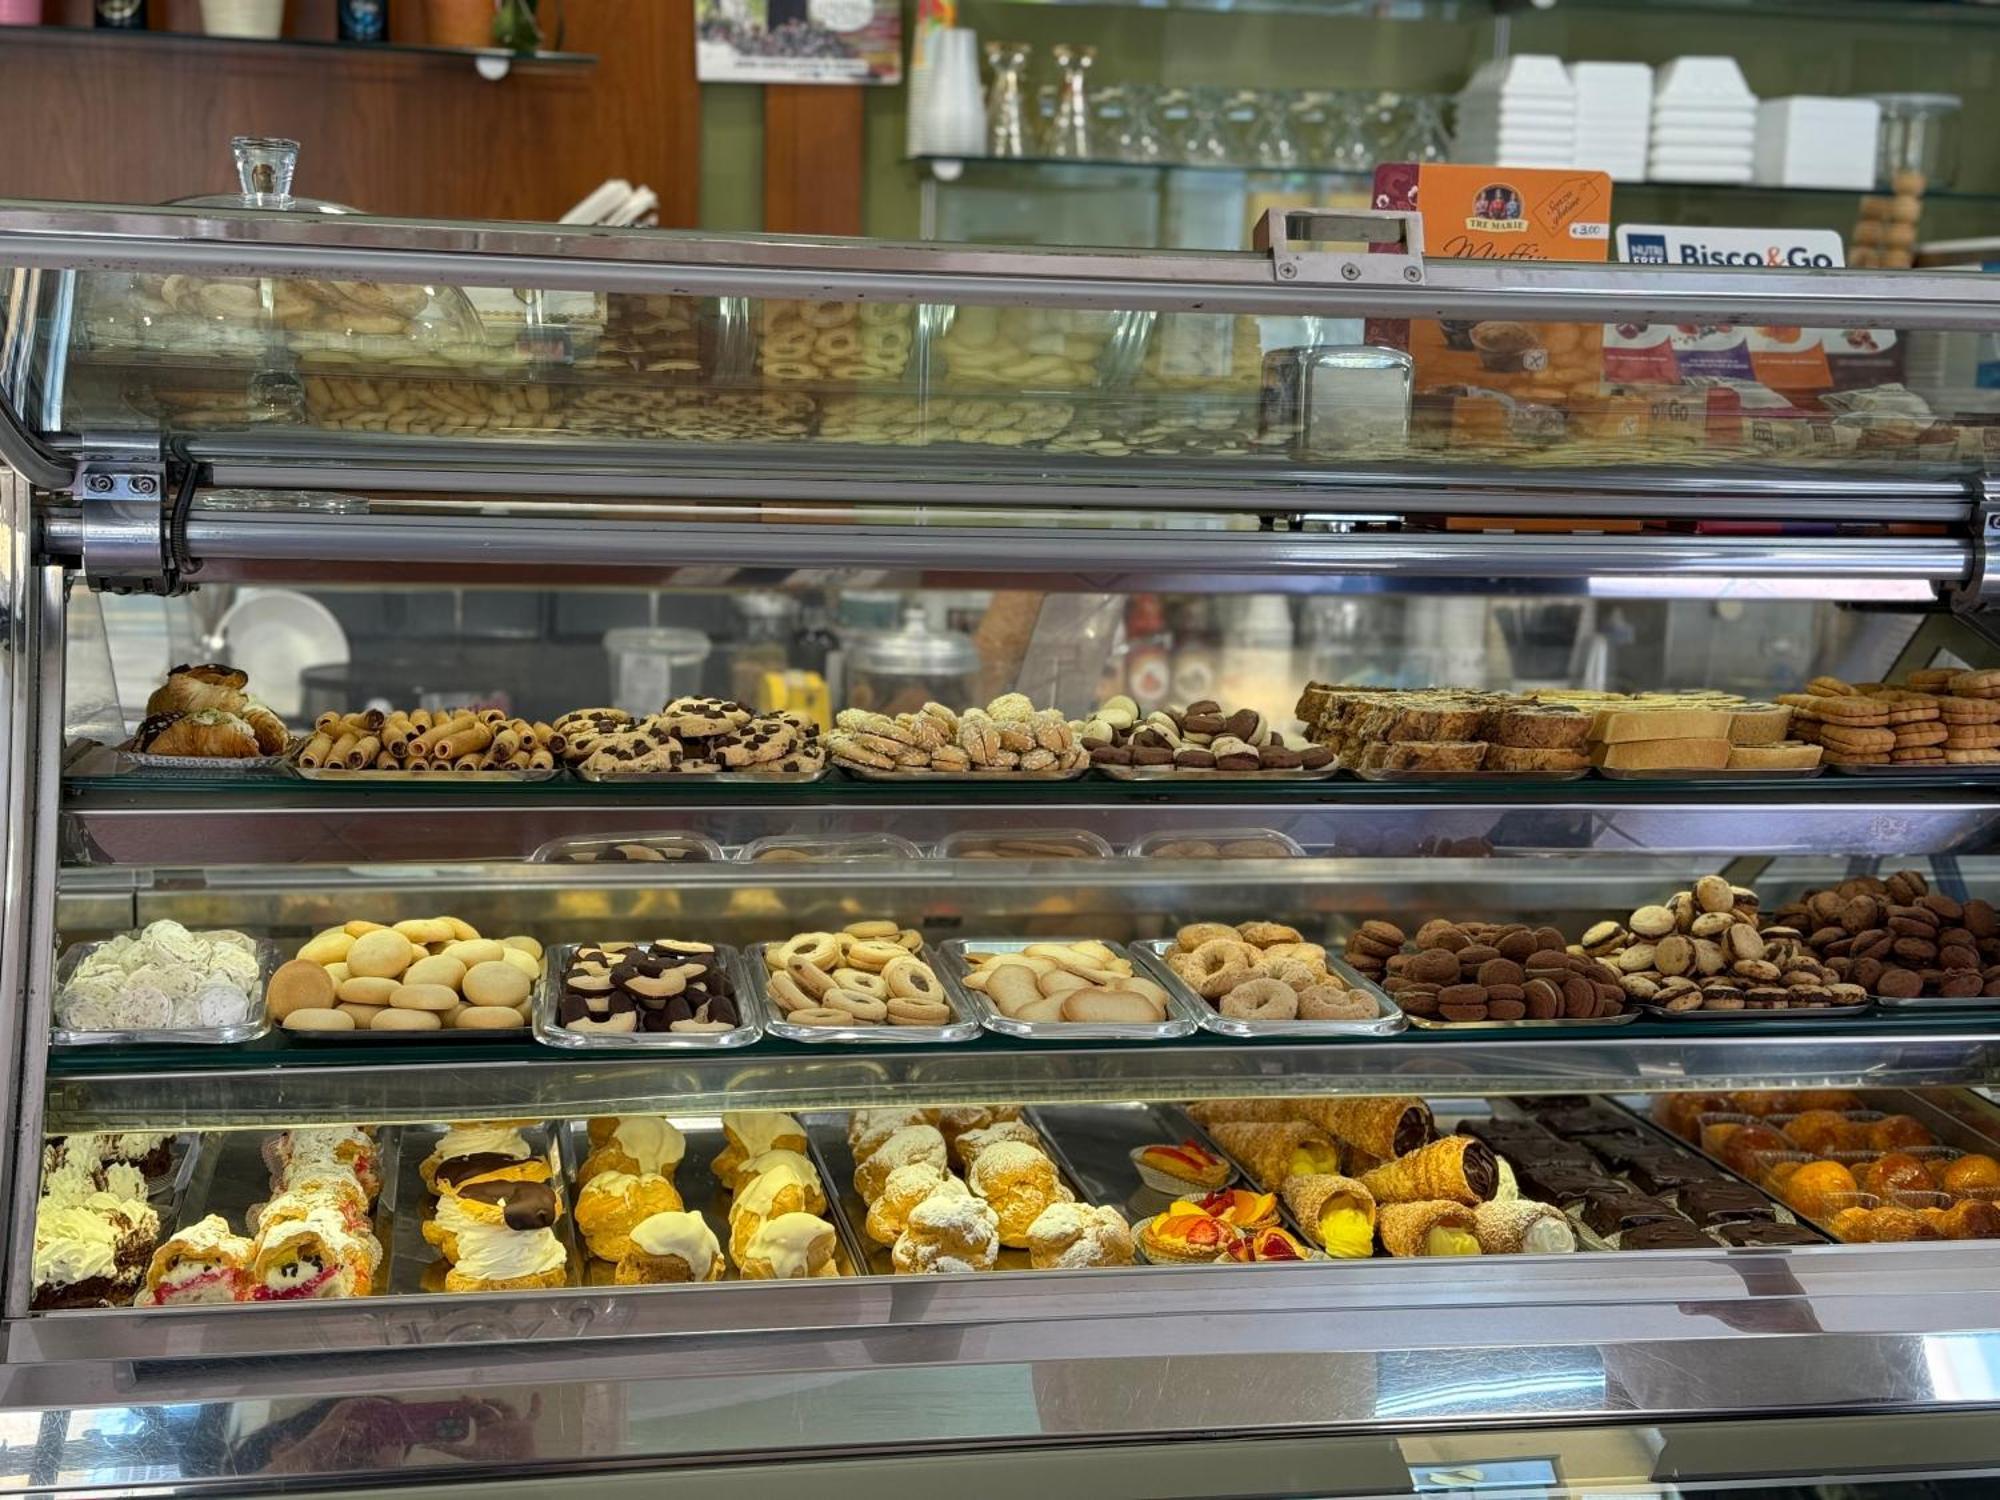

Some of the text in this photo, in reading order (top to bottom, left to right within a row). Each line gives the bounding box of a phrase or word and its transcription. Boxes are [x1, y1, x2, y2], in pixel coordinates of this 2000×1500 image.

[1470, 219, 1524, 229] TRE MARIE
[1631, 244, 1664, 256] NUTRI
[1680, 244, 1833, 267] Bisco&Go
